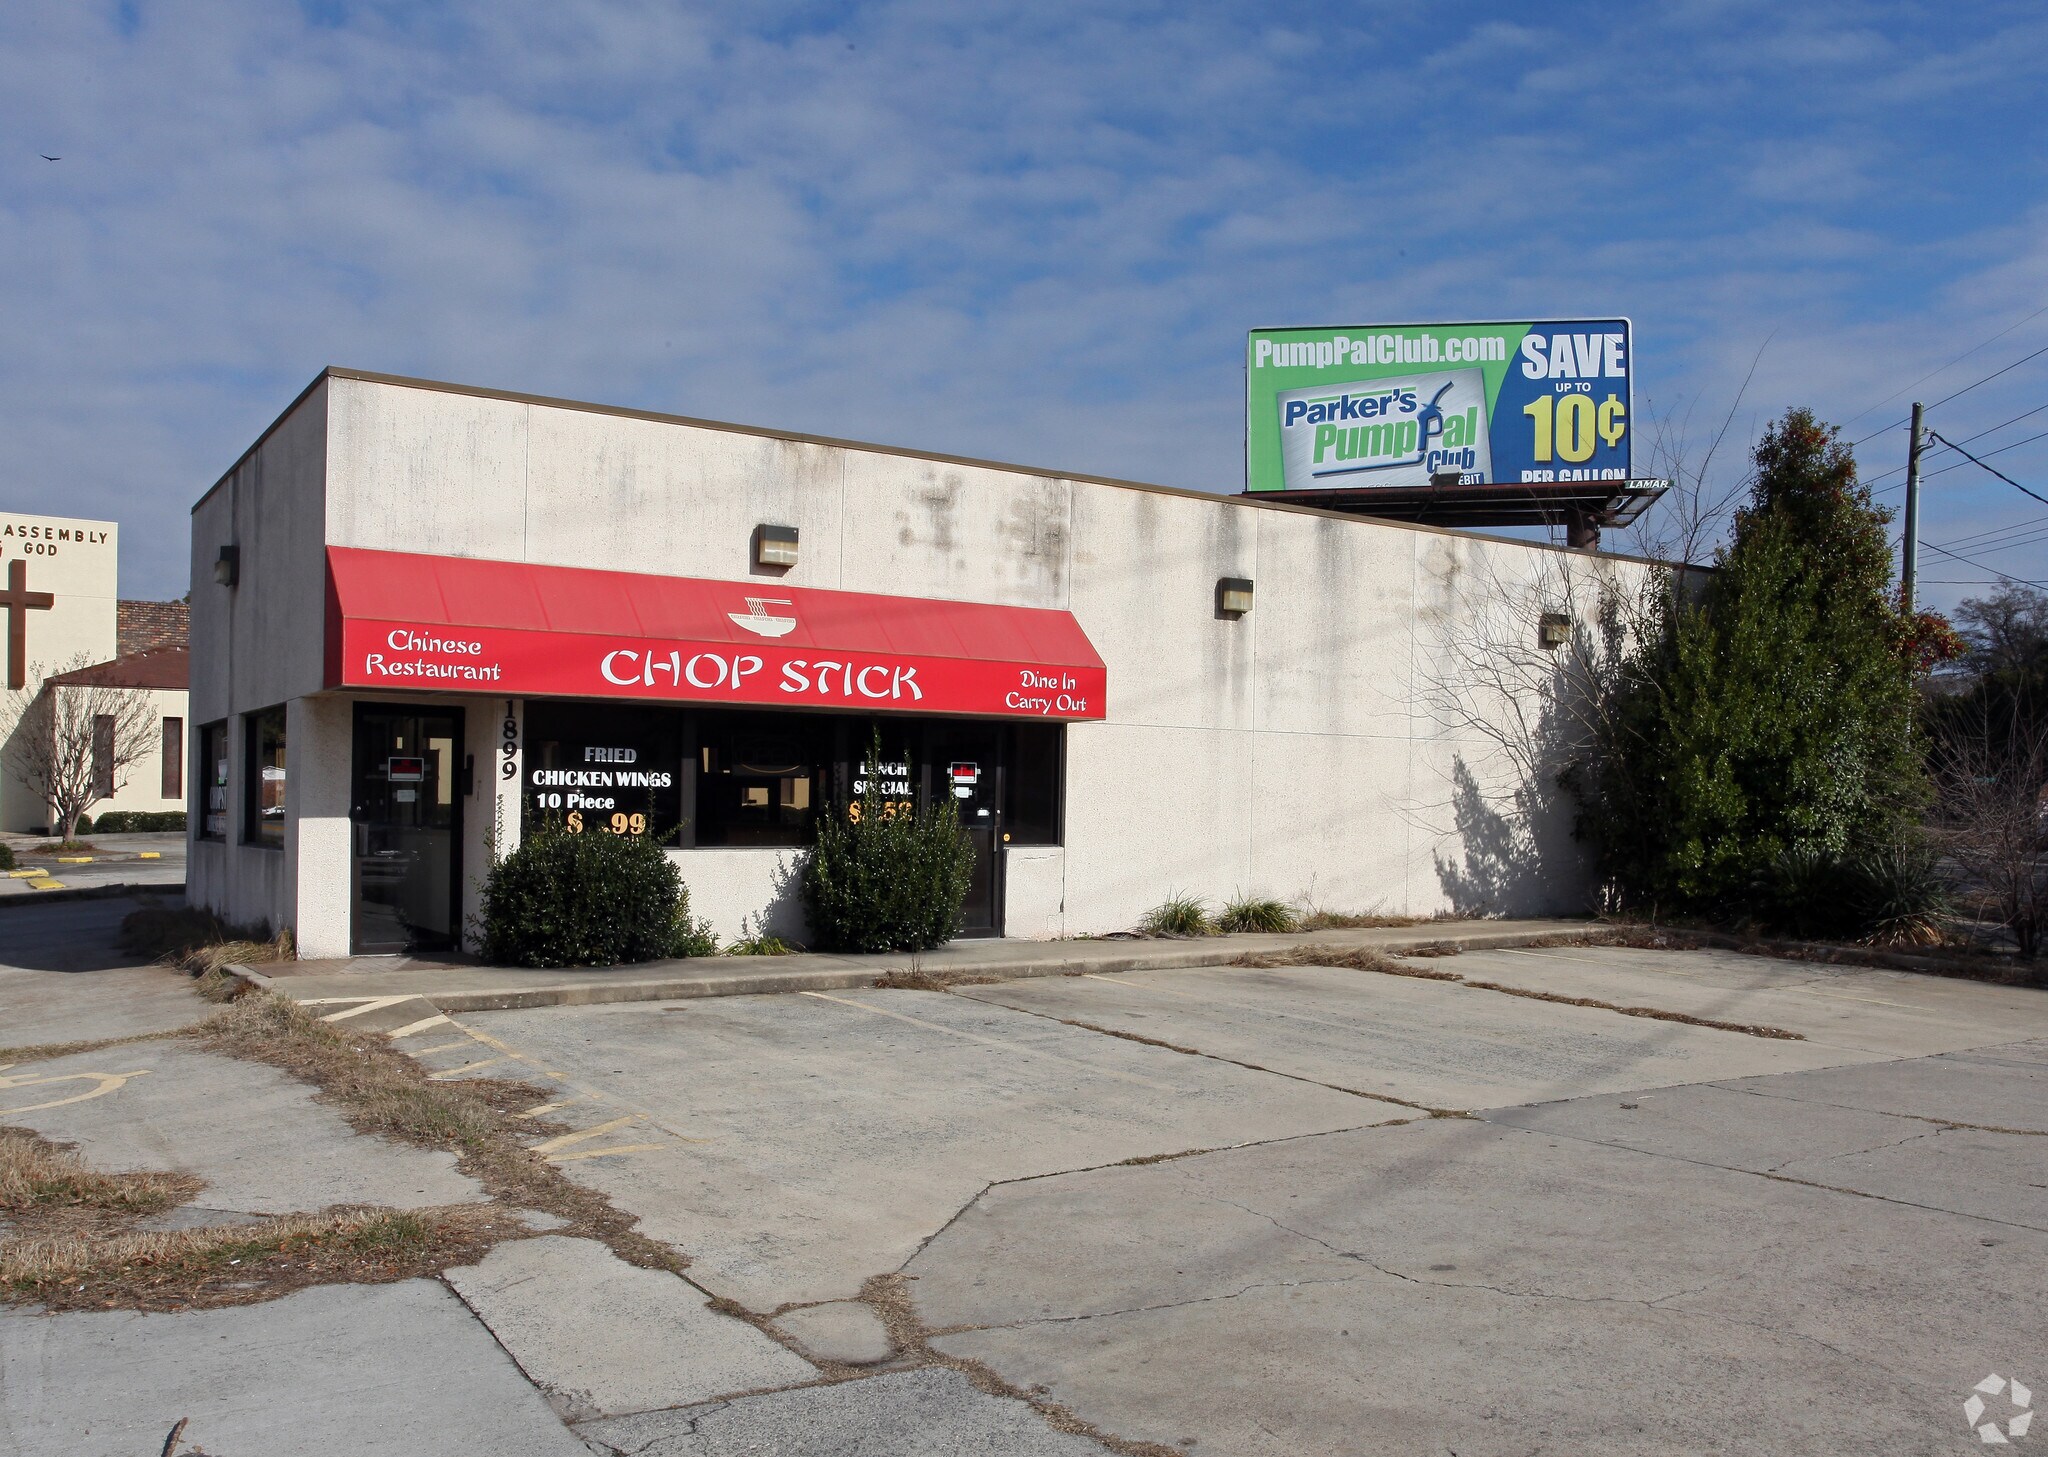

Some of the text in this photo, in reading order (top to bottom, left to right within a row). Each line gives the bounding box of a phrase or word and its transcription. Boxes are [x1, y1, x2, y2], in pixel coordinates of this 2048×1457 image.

[1255, 334, 1506, 368] PumpPalClub.com
[1521, 334, 1625, 379] SAVE
[1555, 382, 1591, 392] UP TO
[1285, 388, 1417, 427] Parker's
[1523, 394, 1625, 462] 10¢
[1427, 447, 1475, 473] Club
[1630, 480, 1669, 488] LAMAR
[4, 524, 107, 544] ASSEMBLY
[24, 542, 57, 556] GOD
[387, 629, 482, 655] Chinese
[366, 653, 501, 681] Restaurant
[600, 650, 923, 700] CHOP STICK
[1019, 670, 1076, 690] Dine In
[1005, 691, 1087, 715] Carry Out
[502, 700, 517, 780] 1899
[584, 746, 638, 763] FRIED
[532, 769, 672, 787] CHICKEN WINGS
[860, 761, 908, 775] LNCH
[853, 780, 913, 795] SPCIAL
[537, 793, 615, 809] 10 Piece
